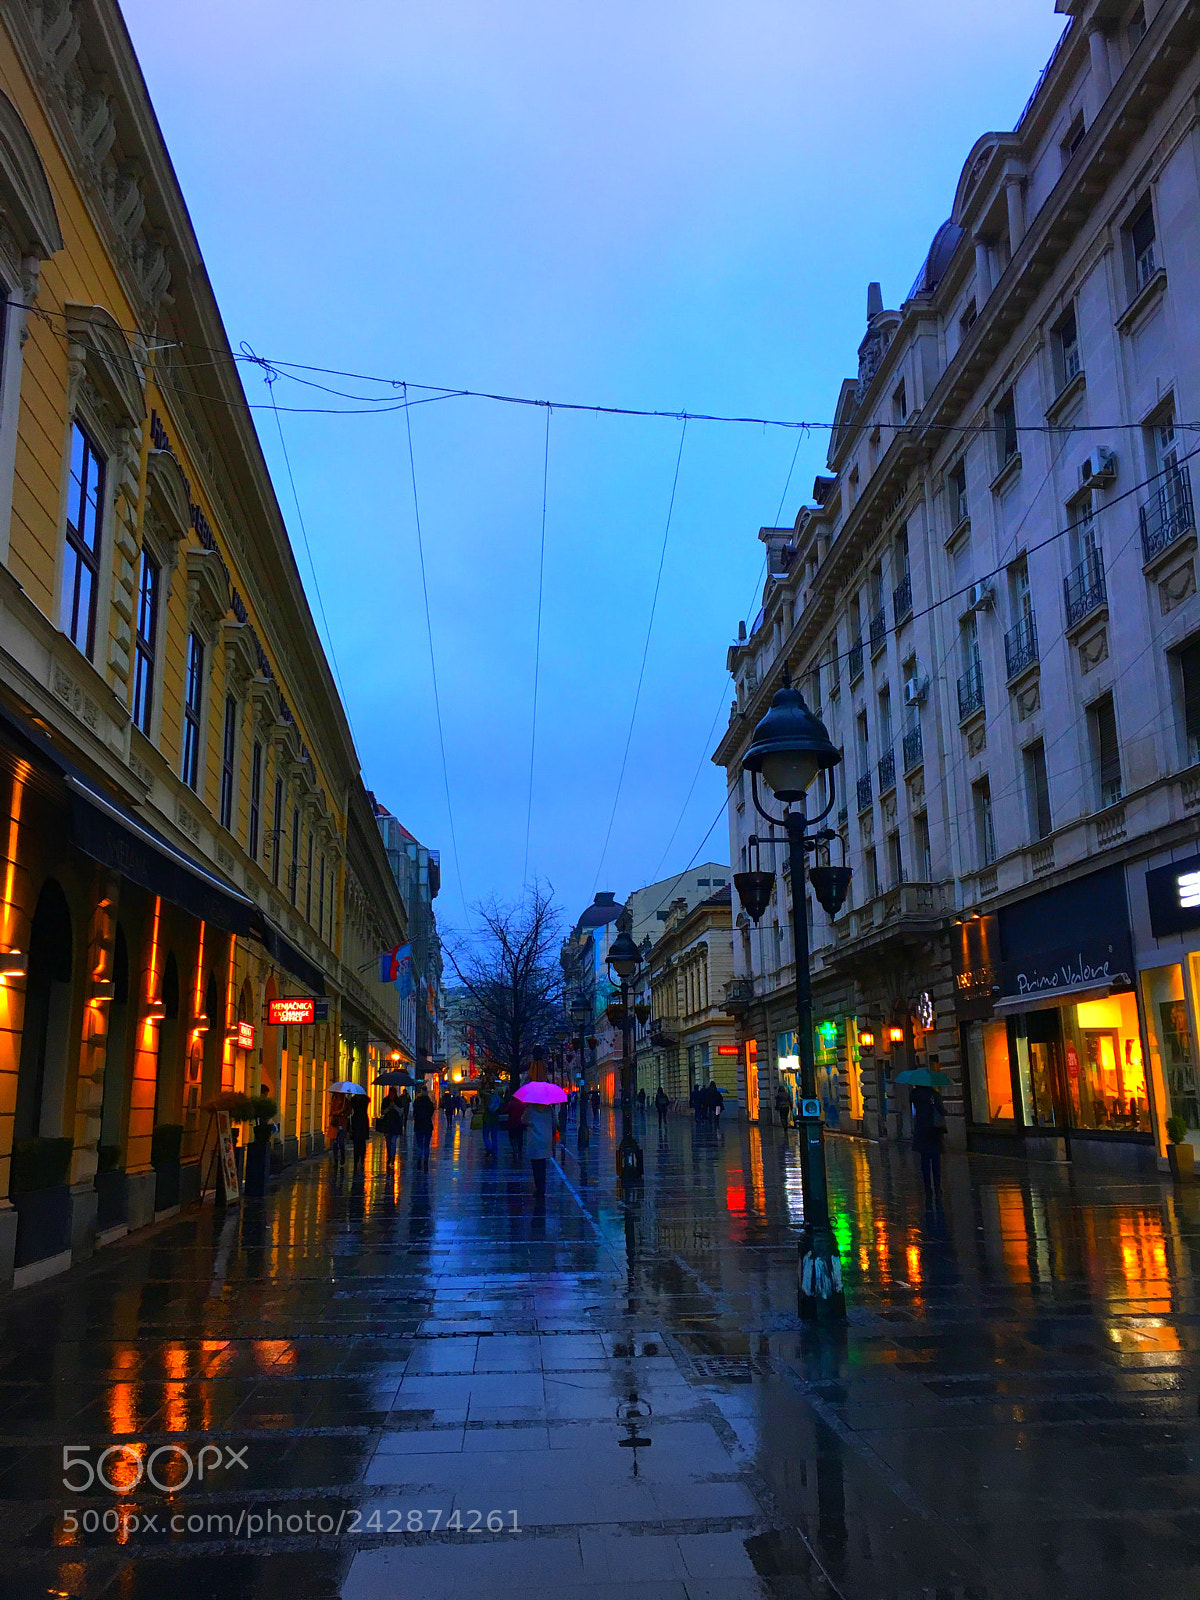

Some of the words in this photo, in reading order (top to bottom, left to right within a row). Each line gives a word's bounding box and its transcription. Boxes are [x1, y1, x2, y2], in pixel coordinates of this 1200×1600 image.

[1017, 969, 1059, 994] Primo
[1061, 953, 1109, 982] Valore
[271, 1001, 312, 1011] MENJAČNICA
